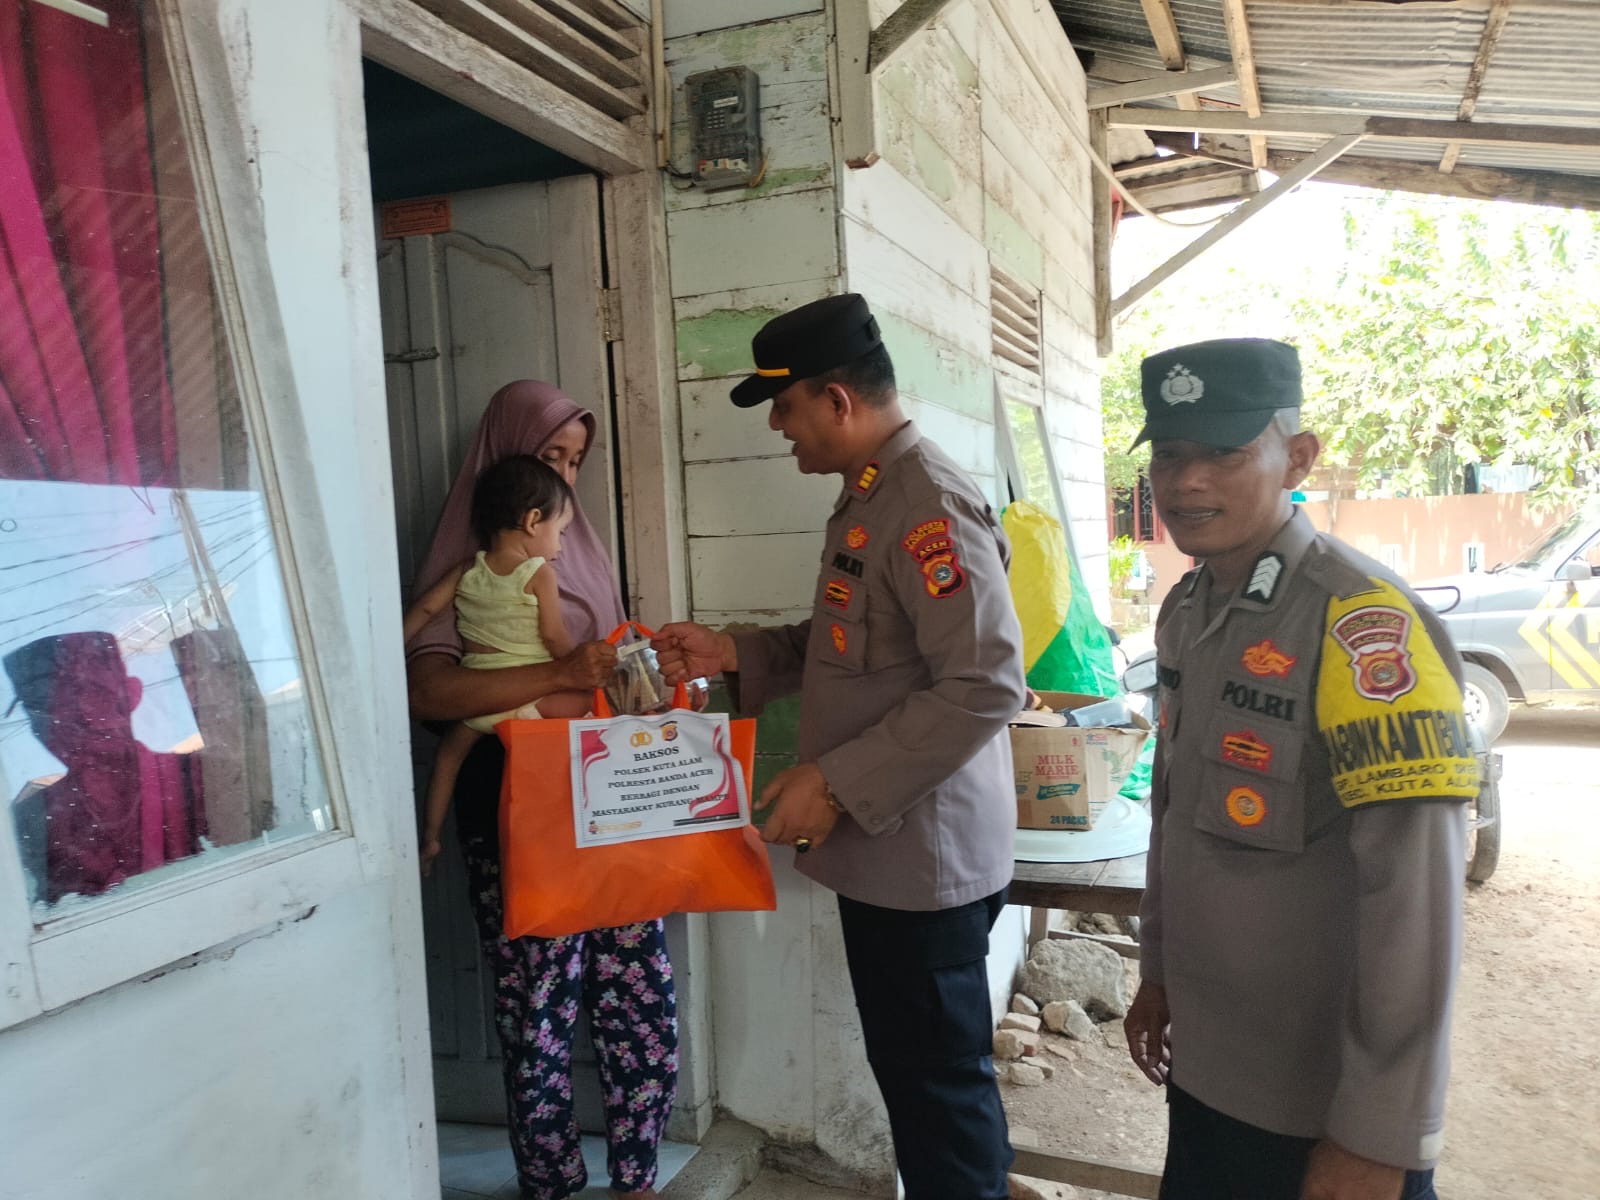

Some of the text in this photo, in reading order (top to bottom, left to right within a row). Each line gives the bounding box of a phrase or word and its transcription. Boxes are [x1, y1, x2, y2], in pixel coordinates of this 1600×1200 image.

[919, 540, 948, 557] ACEH
[1221, 680, 1297, 721] POLRI
[633, 746, 680, 762] BAKSOS
[1037, 754, 1075, 765] MILK
[613, 756, 703, 776] POLSEK KUTA ALAM
[1034, 765, 1079, 776] MARIE
[1358, 763, 1446, 785] LAMBARO
[607, 768, 714, 789] POLRESTA BANDA ACEH
[1375, 779, 1435, 794] KUTA
[620, 784, 700, 801] BERBAGI DENGAN
[655, 797, 693, 810] KURANG
[1049, 815, 1061, 825] 24
[1061, 815, 1088, 825] PACKS
